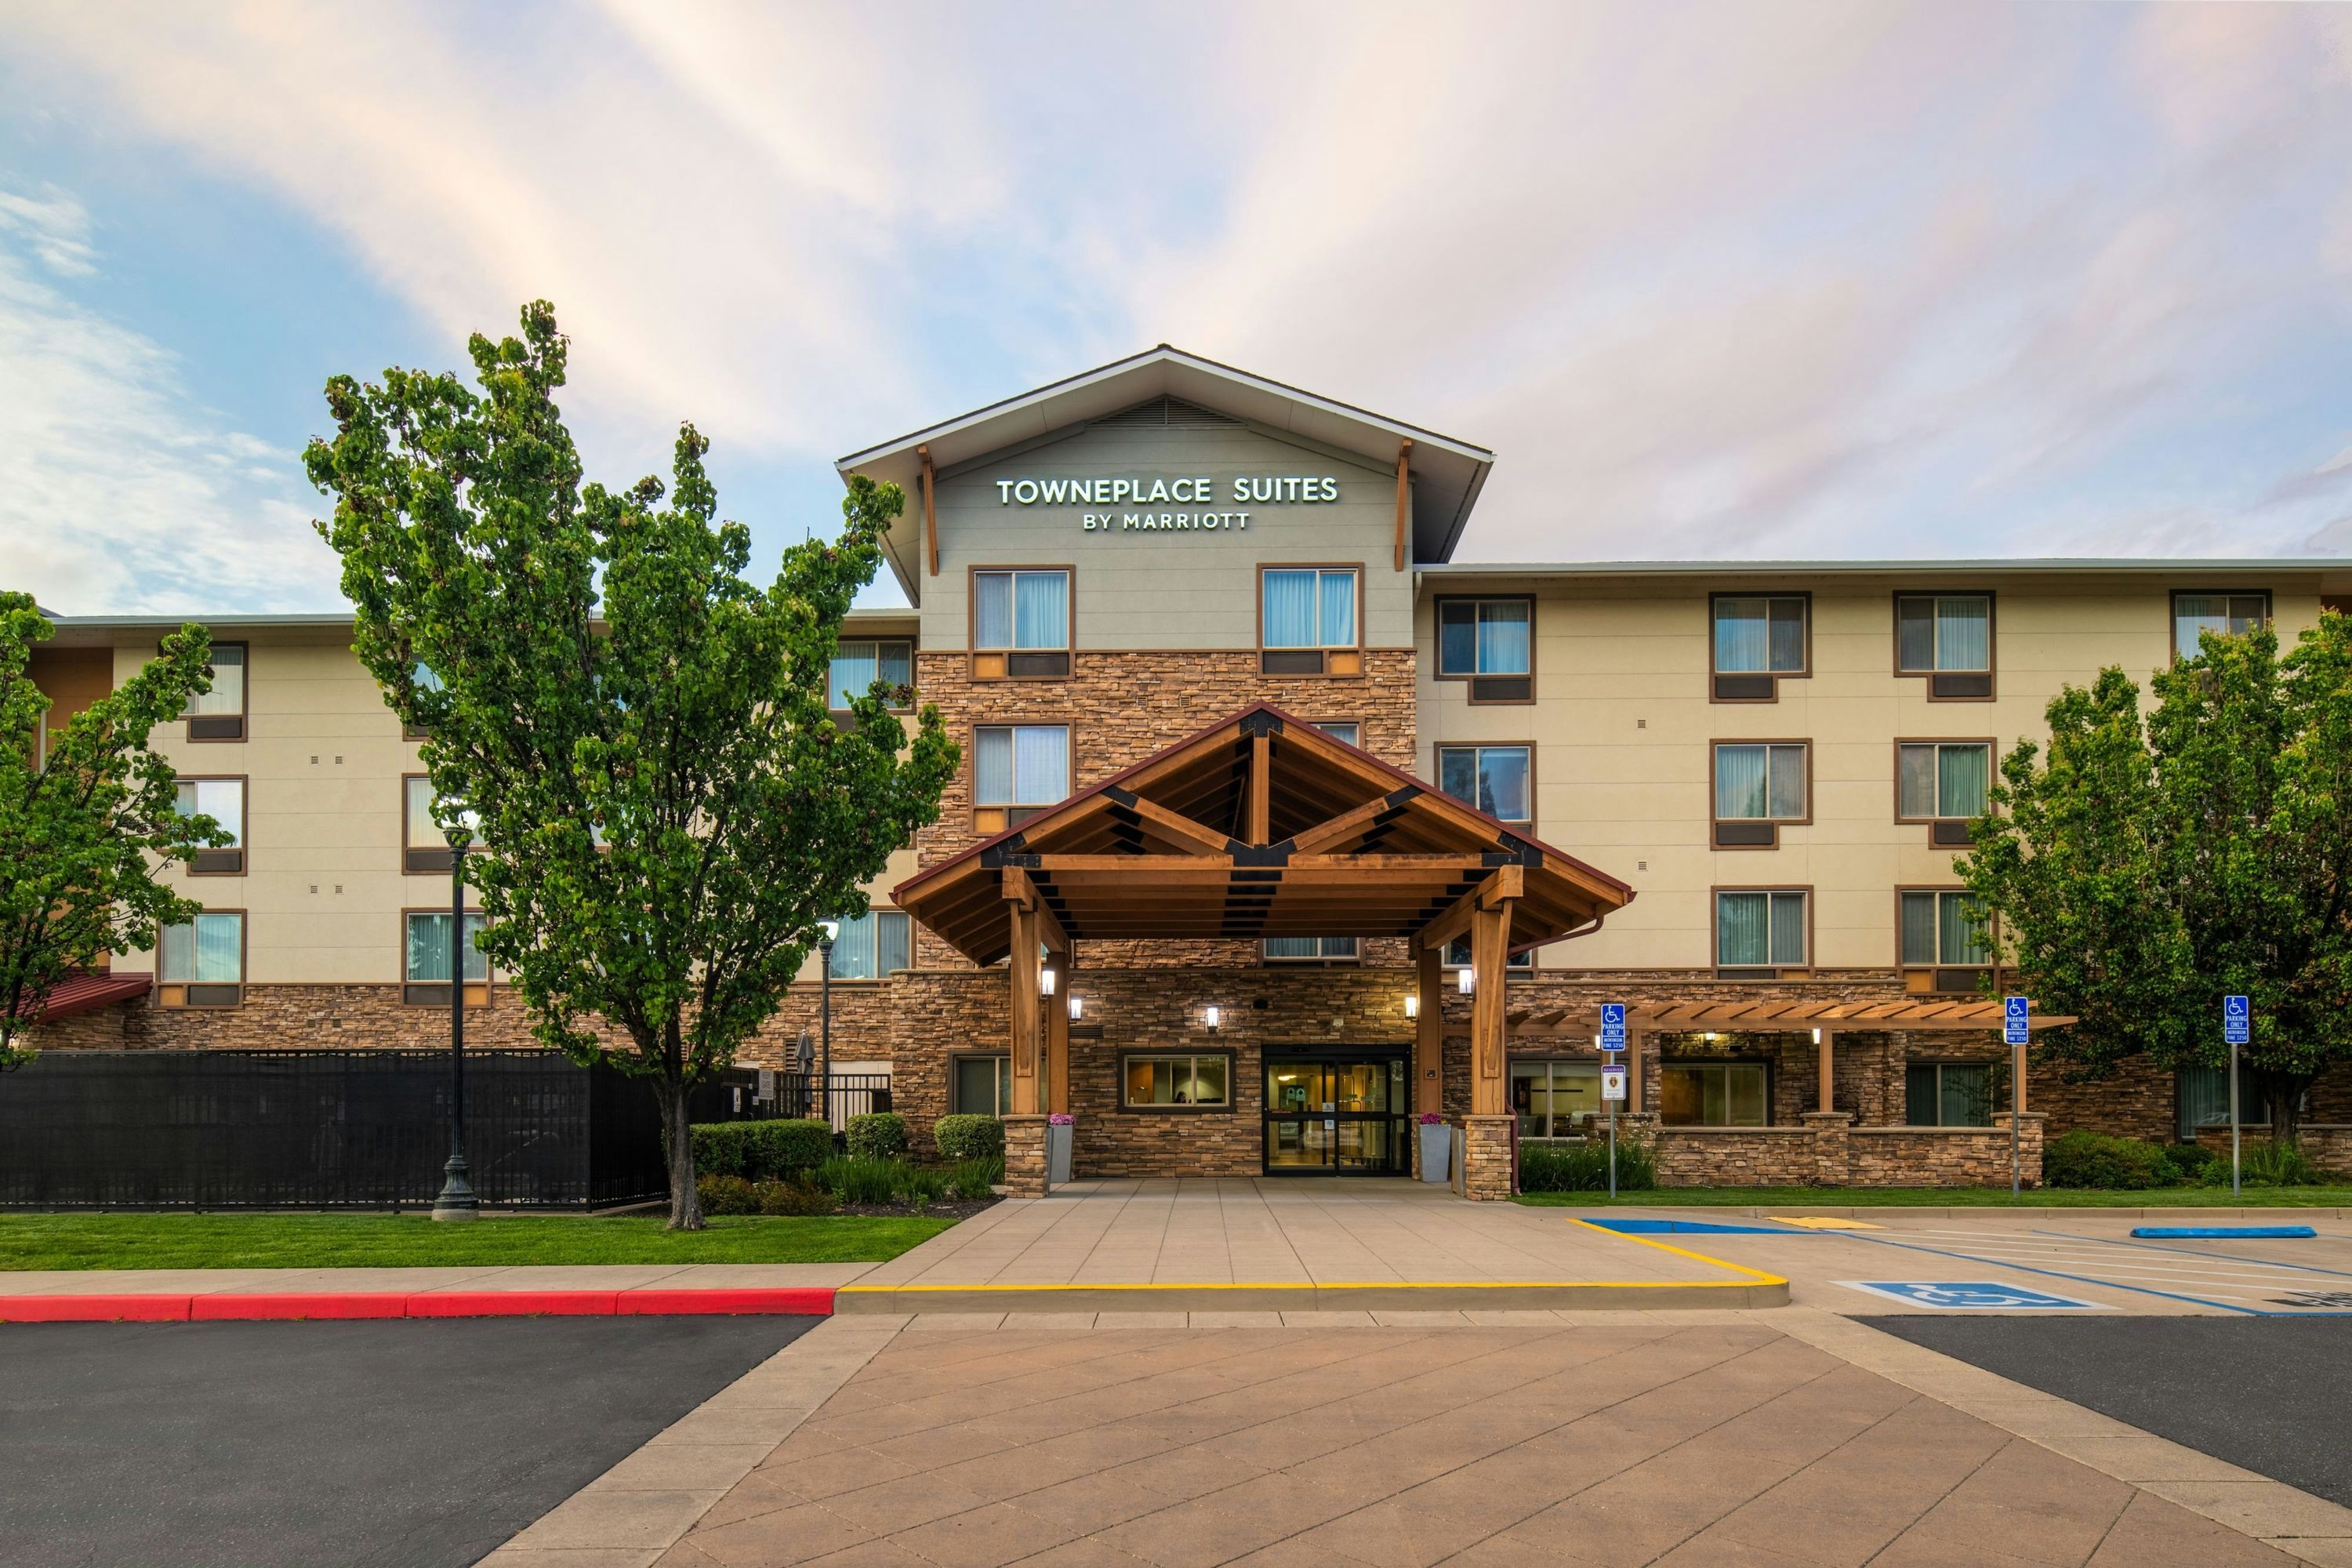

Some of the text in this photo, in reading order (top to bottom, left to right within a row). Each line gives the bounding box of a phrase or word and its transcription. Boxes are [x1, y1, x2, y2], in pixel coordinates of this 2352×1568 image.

[996, 477, 1338, 505] TOWNEPLACE SUITES
[1083, 513, 1250, 530] BY MARRIOTT
